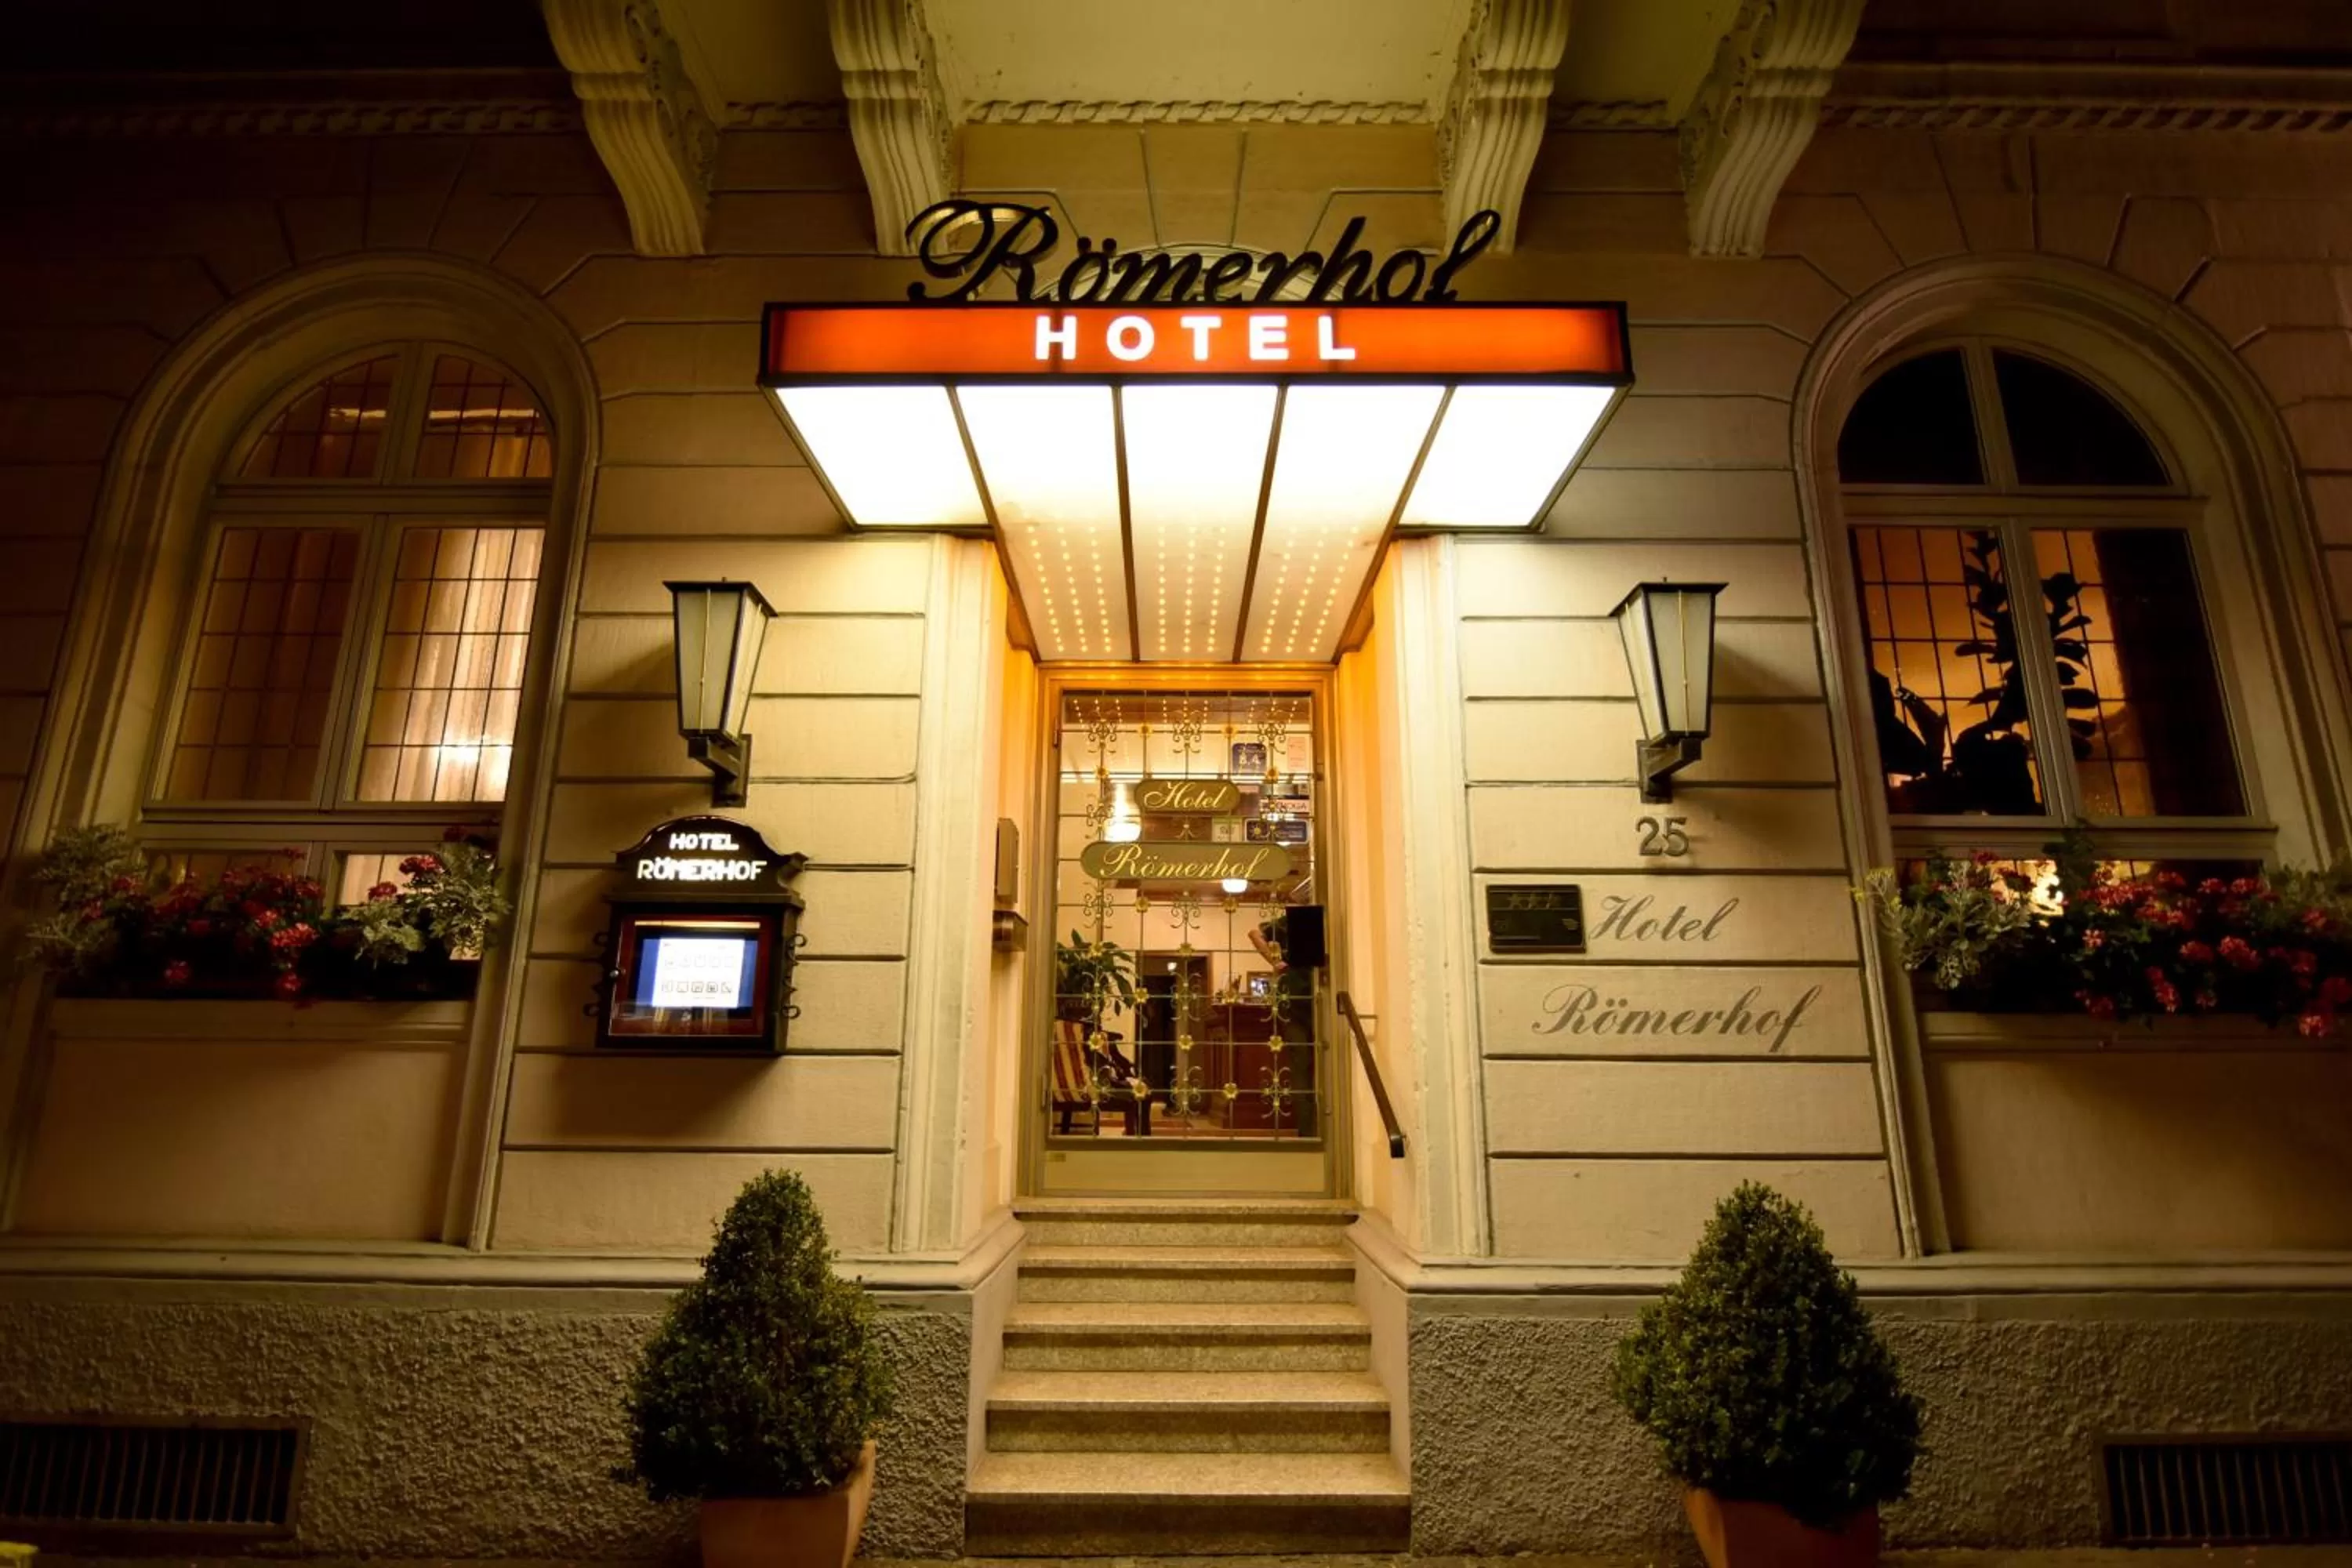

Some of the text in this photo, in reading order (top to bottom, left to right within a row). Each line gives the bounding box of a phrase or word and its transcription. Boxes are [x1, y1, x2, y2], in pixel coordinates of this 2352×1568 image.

[1034, 315, 1357, 362] HOTEL
[1144, 781, 1227, 809] Hotel
[669, 833, 739, 851] HOTEL
[1635, 816, 1690, 857] 25
[637, 857, 768, 880] RÖMERHOF
[1099, 844, 1269, 879] Römerhof
[1589, 895, 1740, 942] Hotel
[1531, 984, 1823, 1053] Römerhof
